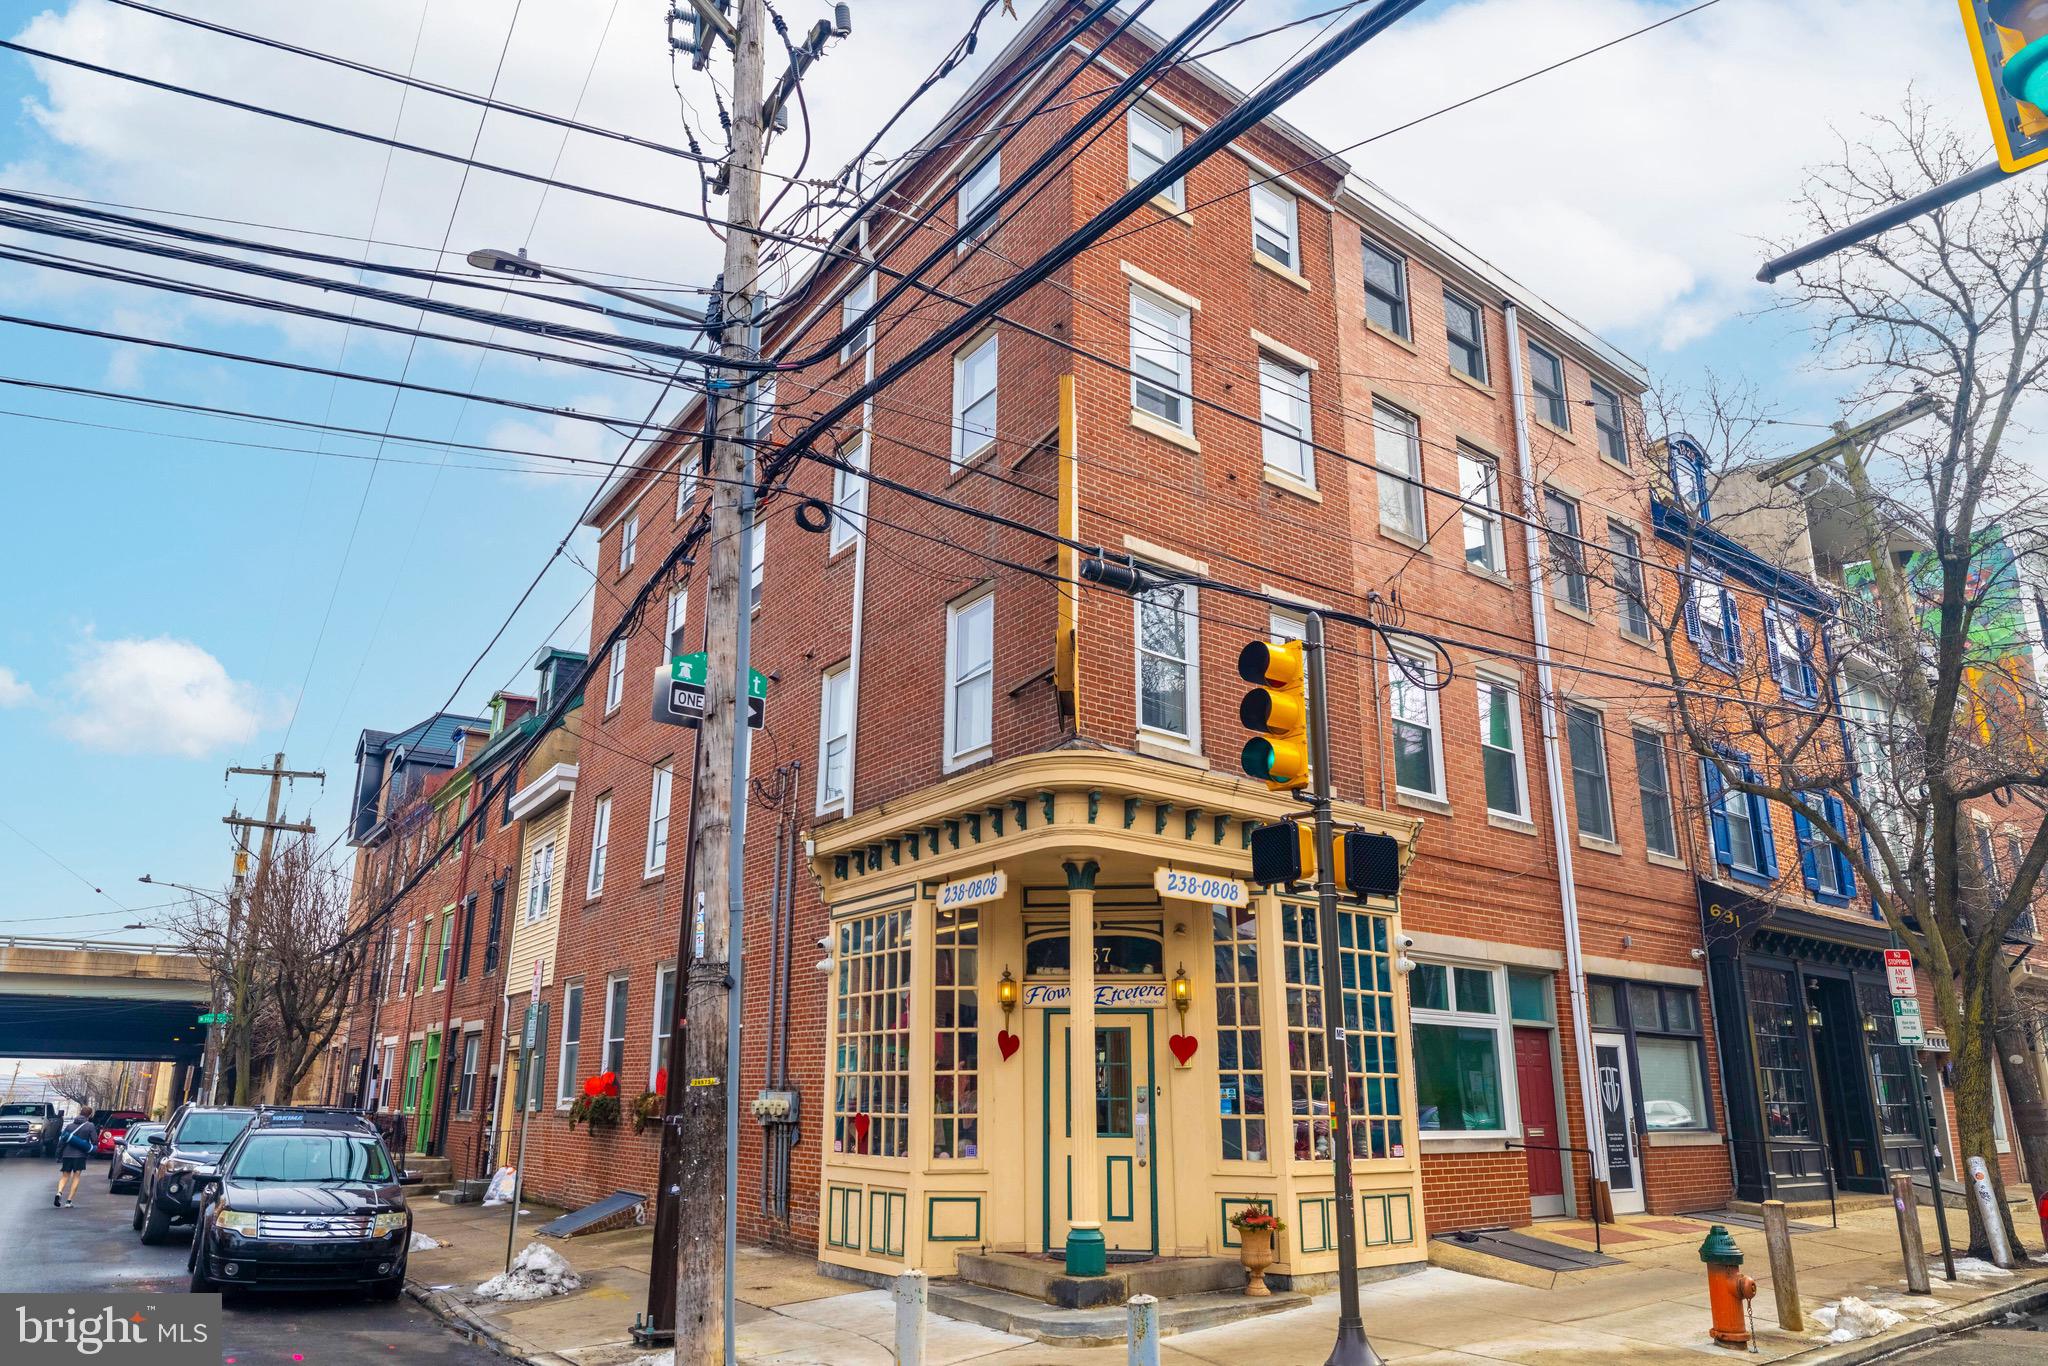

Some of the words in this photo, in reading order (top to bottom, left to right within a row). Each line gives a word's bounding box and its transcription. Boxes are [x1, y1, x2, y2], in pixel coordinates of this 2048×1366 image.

[678, 692, 704, 708] ONE
[943, 876, 998, 905] 238-0808
[1167, 873, 1239, 901] 238-0808
[1710, 903, 1740, 928] 631
[1895, 968, 1905, 976] ANY
[1896, 976, 1908, 984] TIME
[1024, 985, 1071, 1005] Flow
